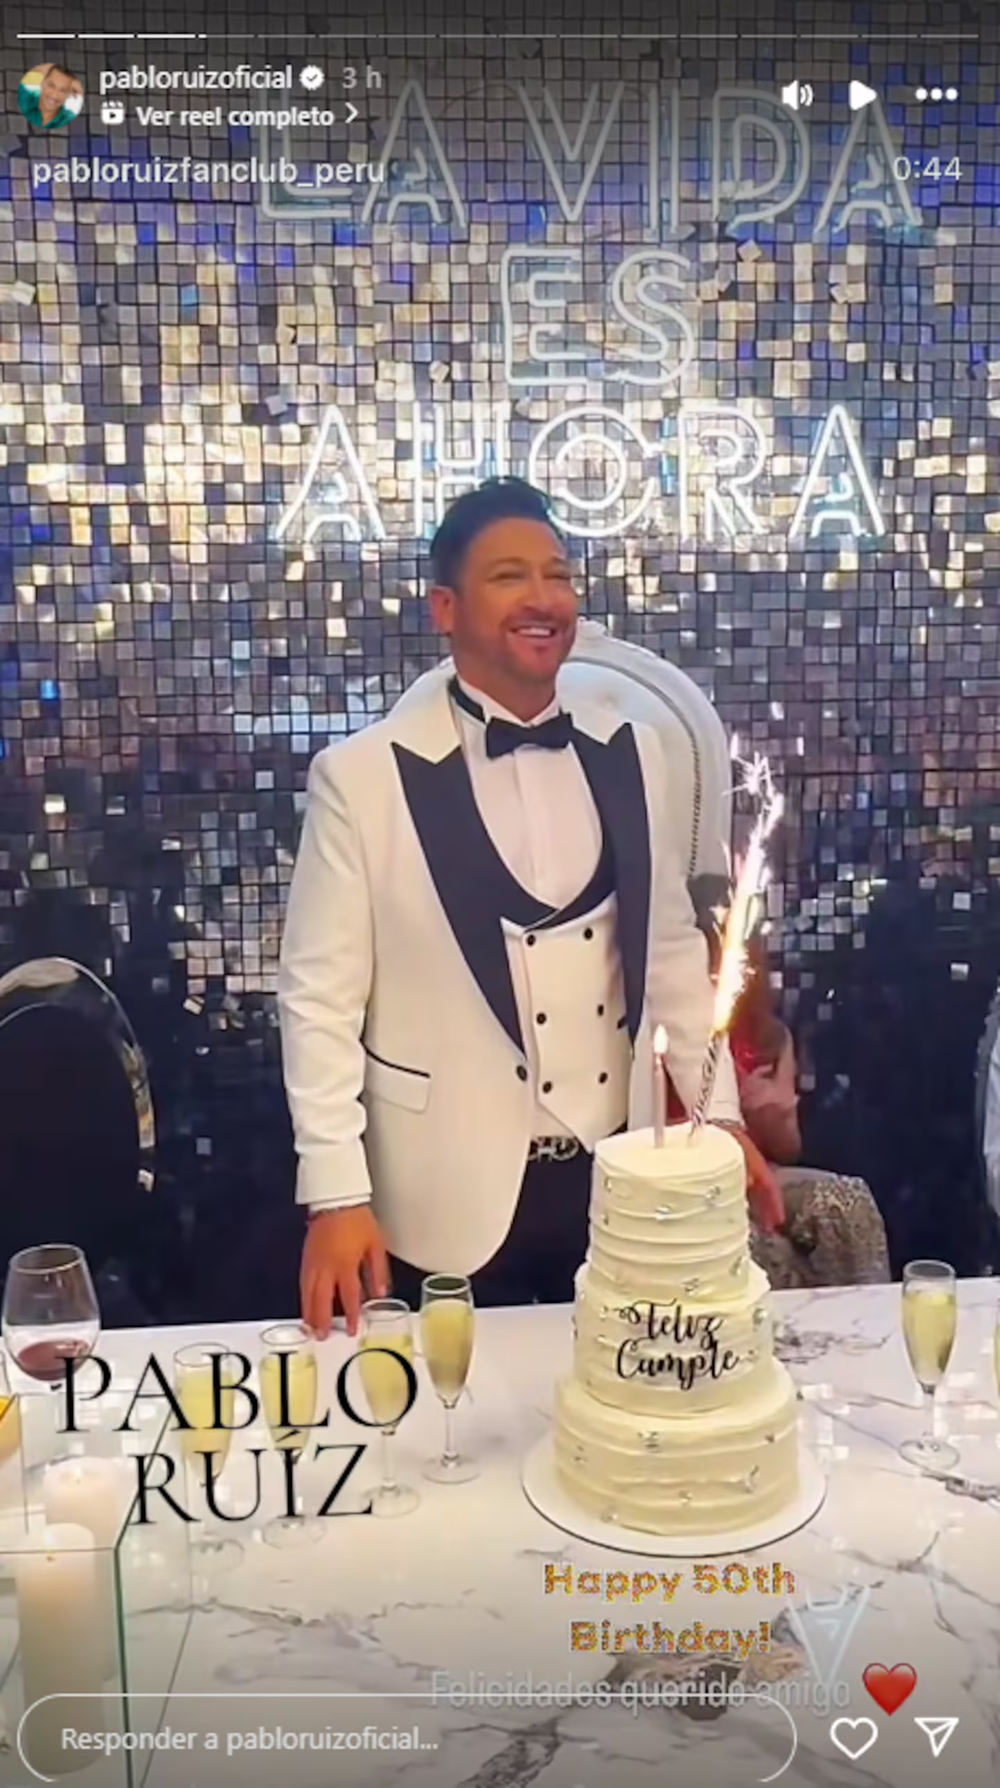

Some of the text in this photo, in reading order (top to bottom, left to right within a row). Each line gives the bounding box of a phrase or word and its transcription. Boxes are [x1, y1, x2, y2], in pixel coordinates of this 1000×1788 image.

[258, 78, 922, 236] LA VIDA
[501, 247, 697, 387] ES
[276, 403, 886, 541] AHORA
[612, 1298, 724, 1350] Feliz
[616, 1337, 739, 1390] Cumple
